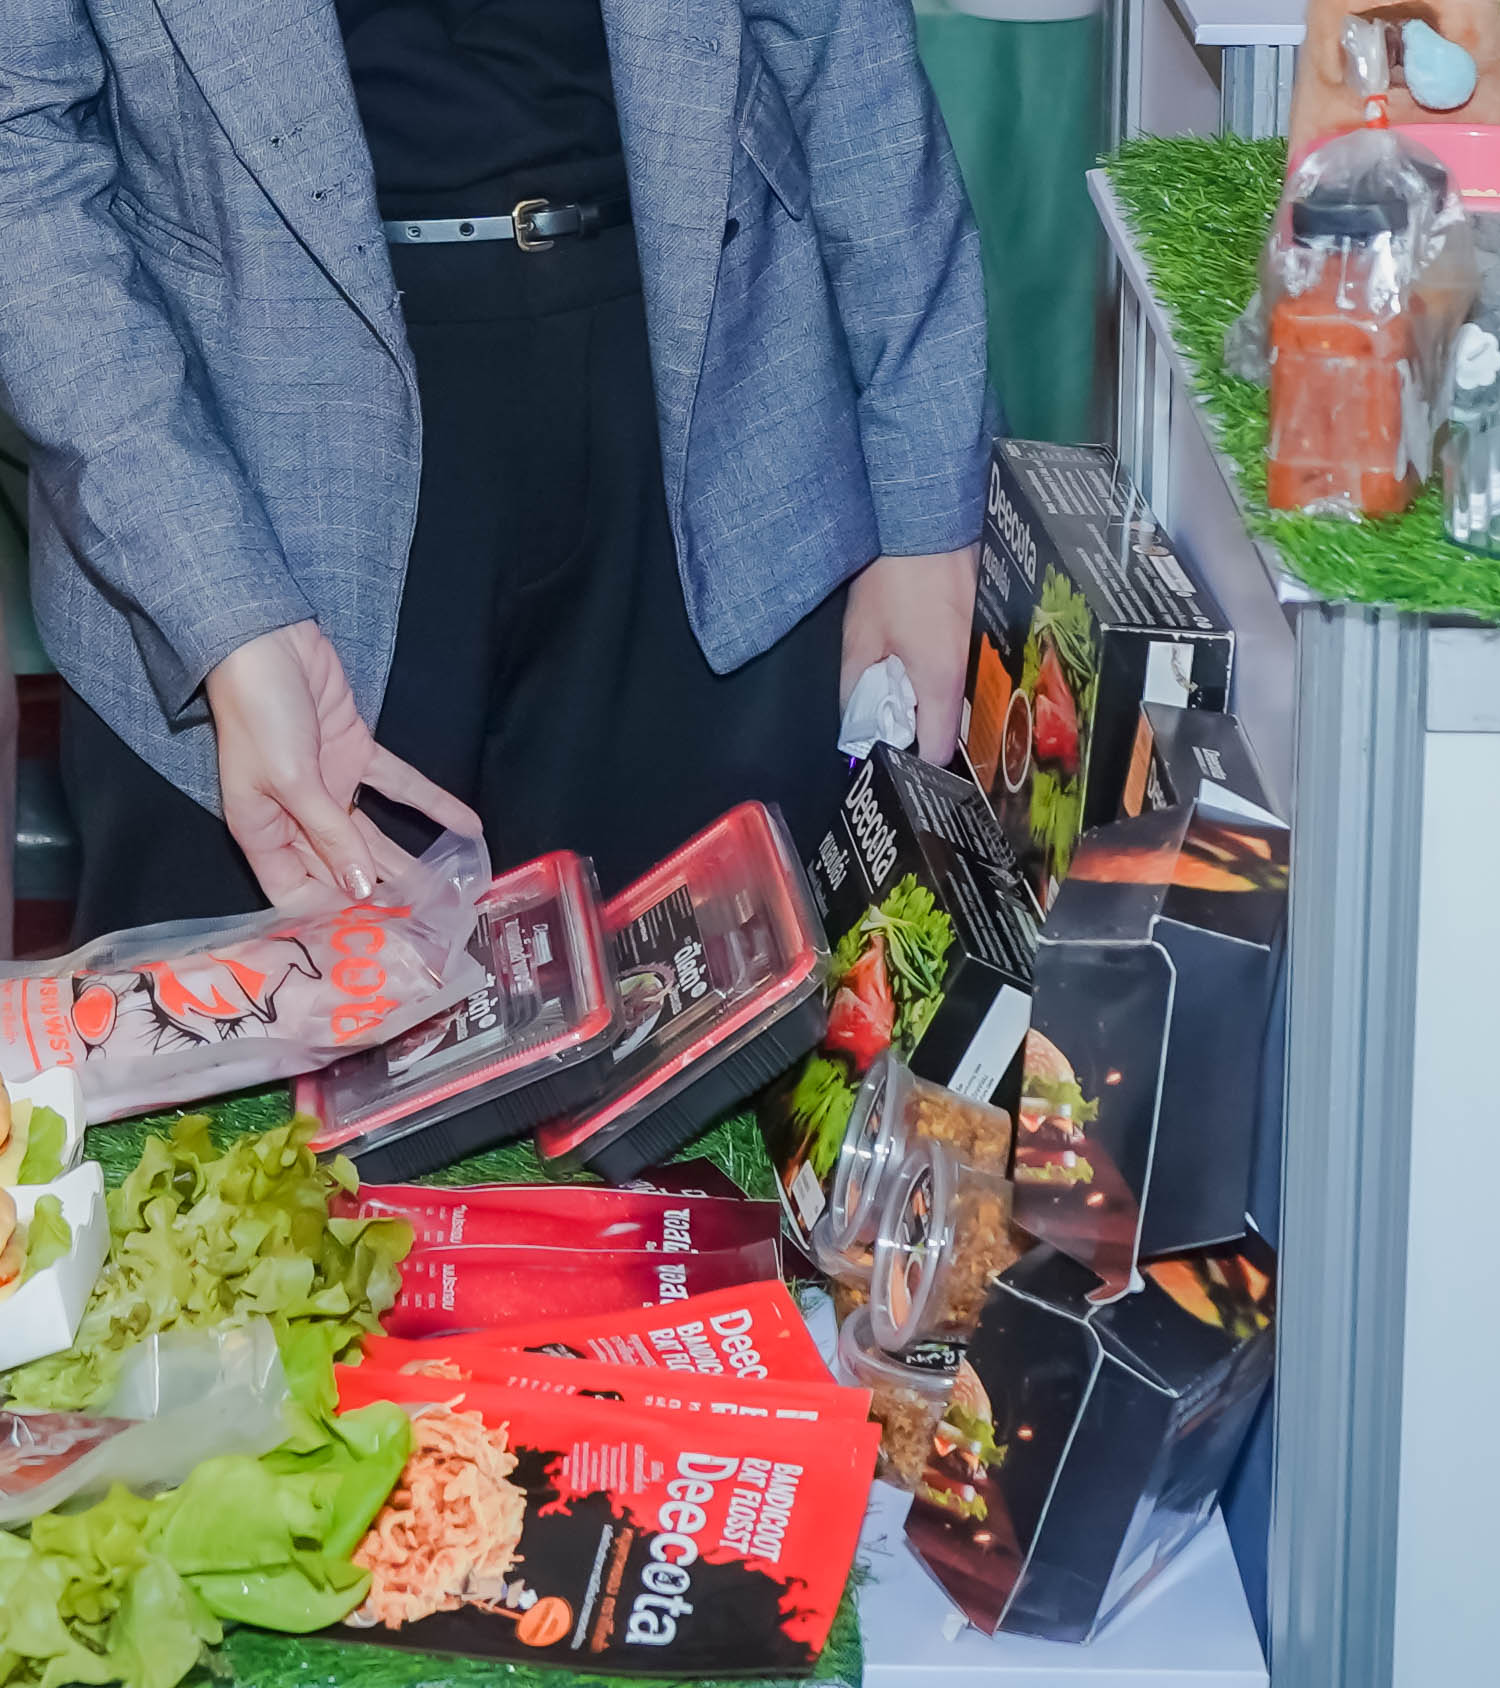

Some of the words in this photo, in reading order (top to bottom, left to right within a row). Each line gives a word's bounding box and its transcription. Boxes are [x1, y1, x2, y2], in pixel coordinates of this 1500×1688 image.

[987, 460, 1038, 582] Deecota
[843, 757, 902, 889] Deecota
[678, 1320, 724, 1376] BANDIC
[709, 1308, 769, 1382] Deec
[741, 1457, 772, 1492] RAT
[760, 1462, 805, 1564] BANDICOOT
[625, 1451, 740, 1648] Deecota
